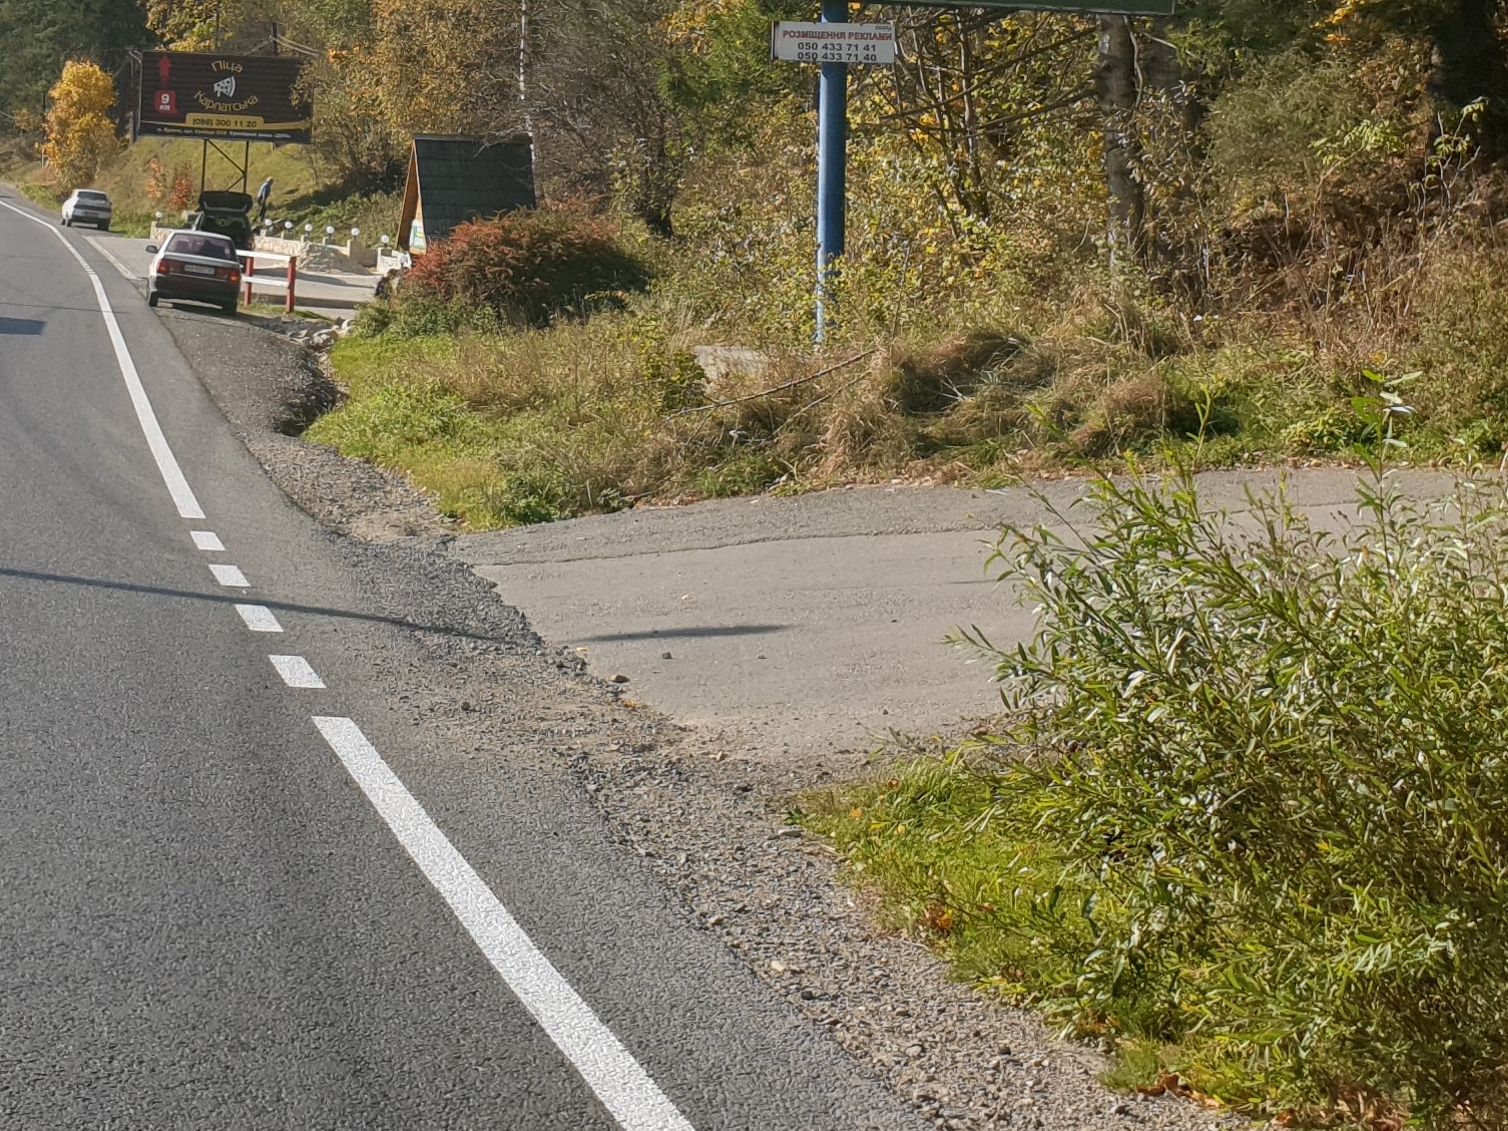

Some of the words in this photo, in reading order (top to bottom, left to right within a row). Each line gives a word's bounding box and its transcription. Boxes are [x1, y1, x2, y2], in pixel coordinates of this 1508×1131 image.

[797, 42, 818, 50] 050
[821, 43, 842, 51] 433
[846, 43, 859, 51] 71
[863, 44, 876, 52] 41
[797, 52, 818, 60] 050
[821, 53, 842, 61] 433
[846, 53, 859, 61] 71
[211, 60, 243, 73] Піца
[161, 93, 170, 104] 9
[194, 90, 259, 112] Карпатська
